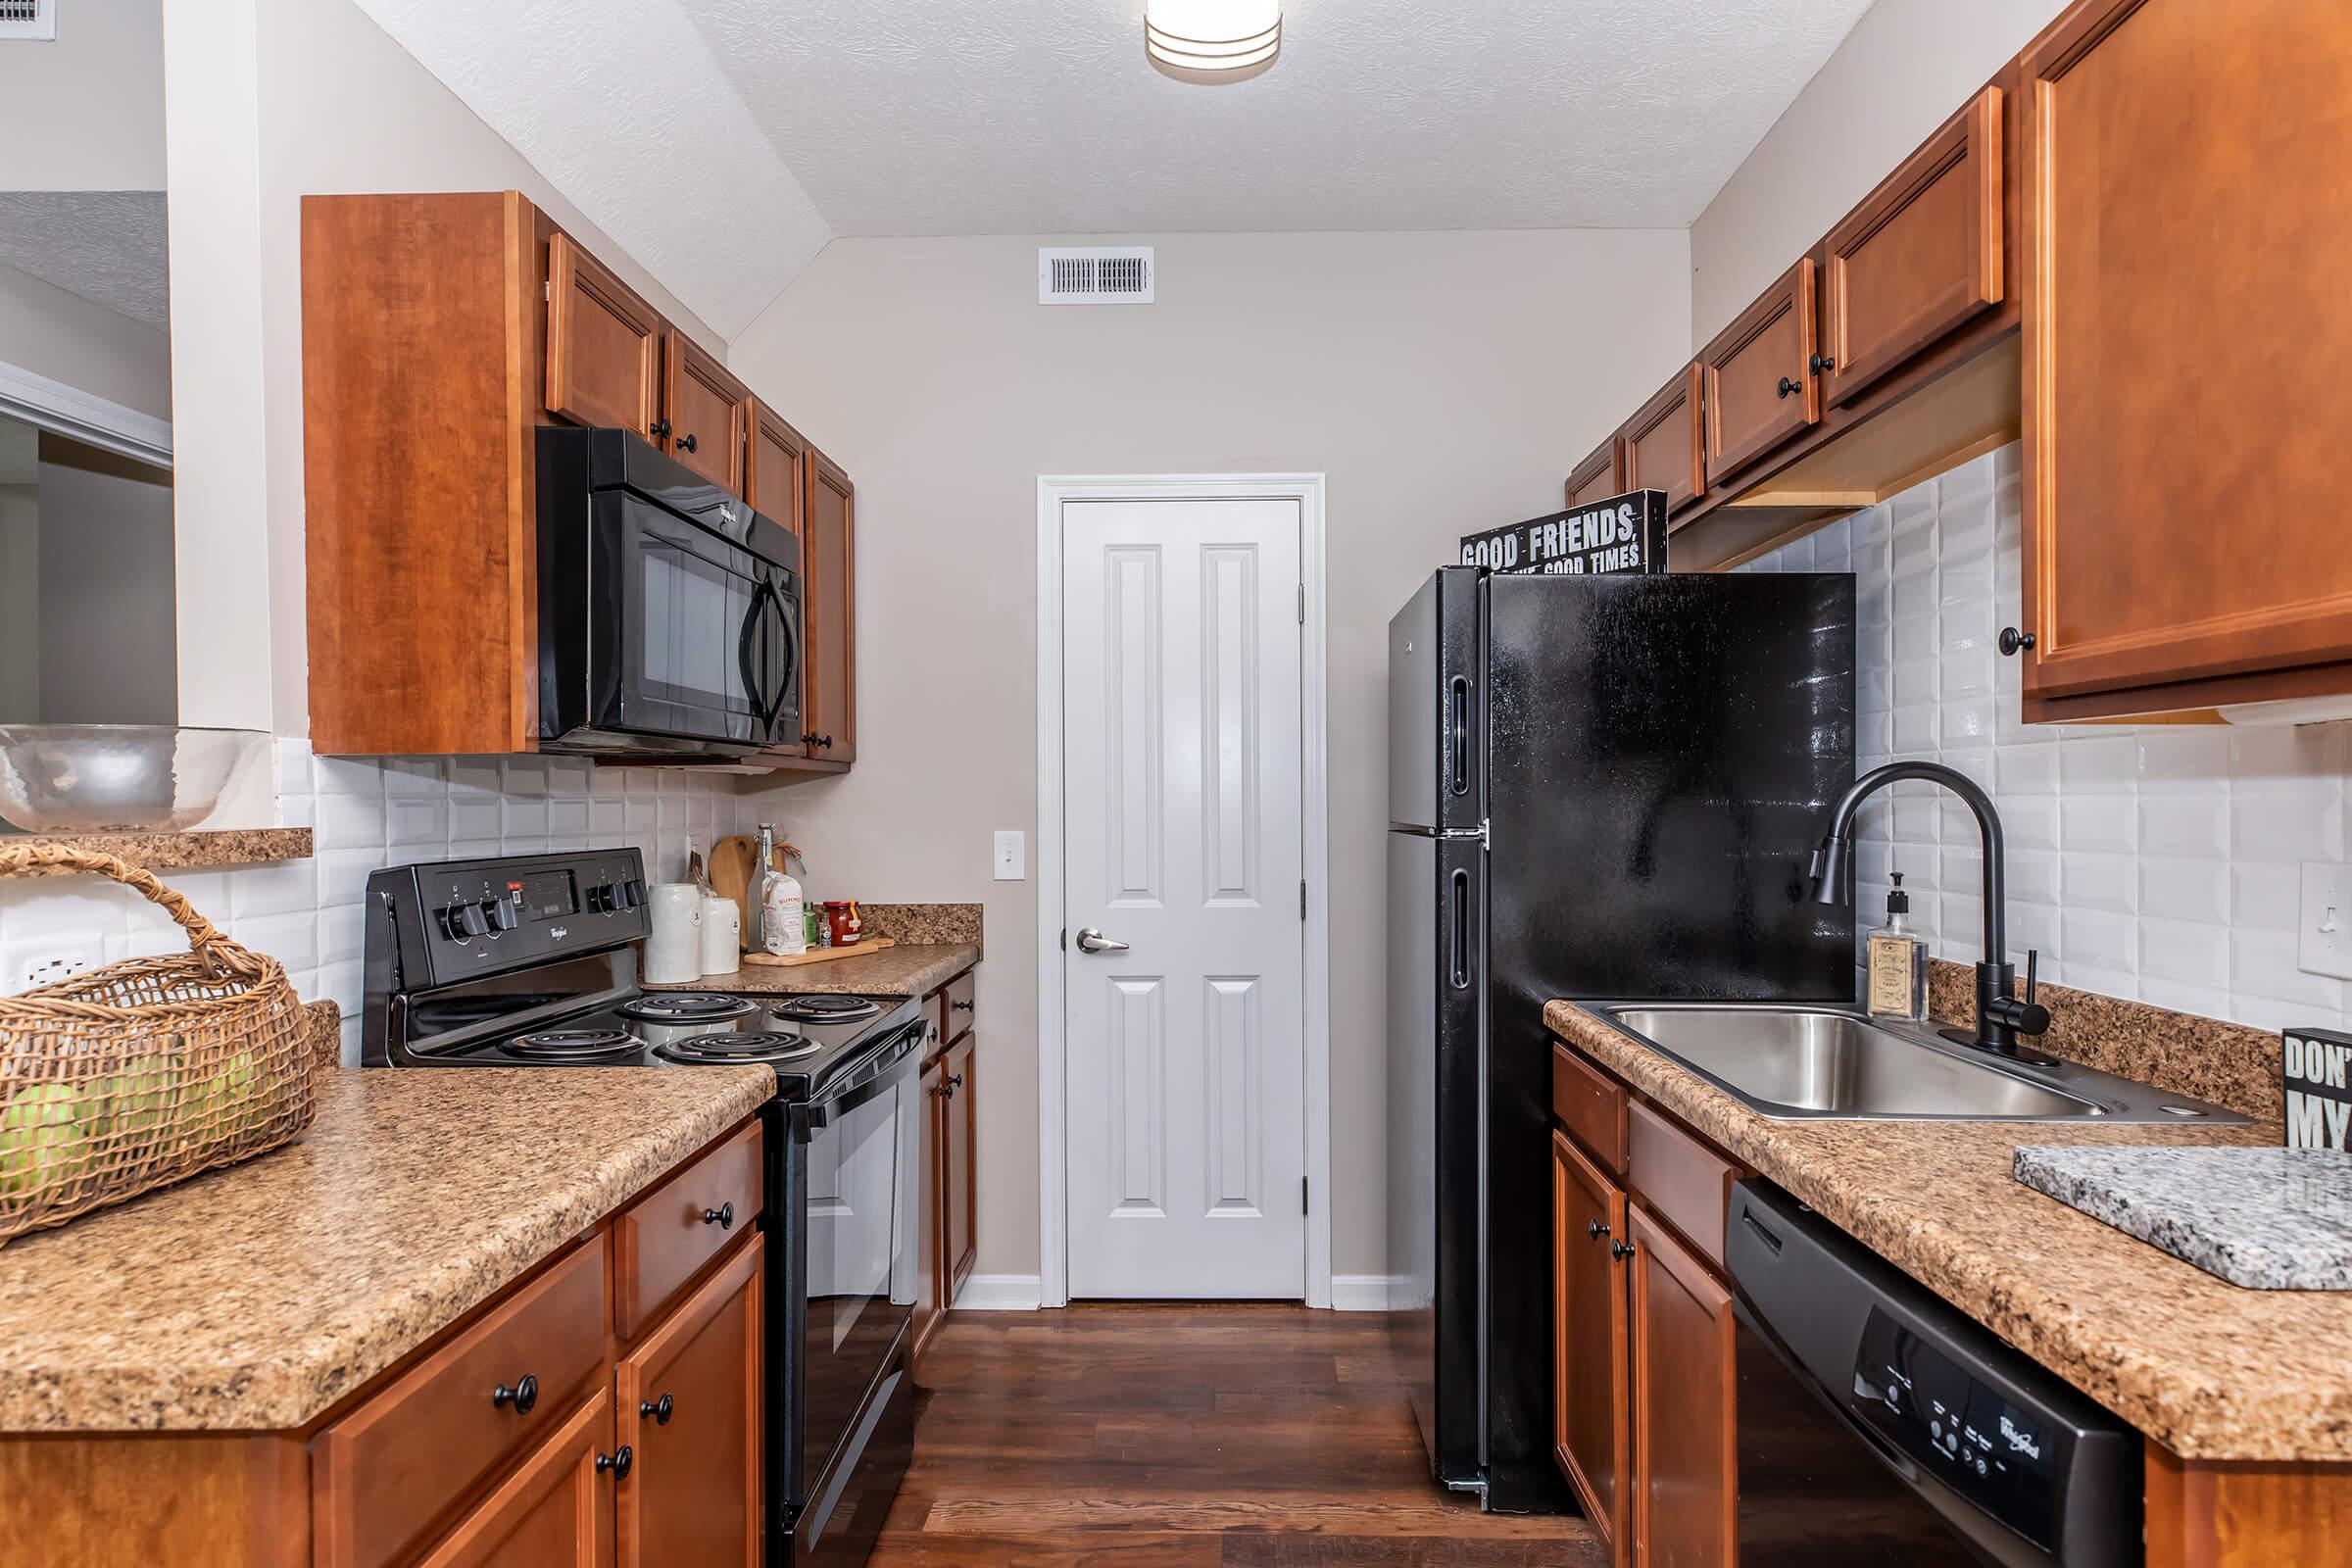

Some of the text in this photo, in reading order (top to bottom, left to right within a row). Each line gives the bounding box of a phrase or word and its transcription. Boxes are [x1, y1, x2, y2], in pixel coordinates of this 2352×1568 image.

[1462, 533, 1518, 570] GOOD
[2285, 1036, 2352, 1089] DON'
[2286, 1090, 2351, 1152] MY
[2000, 1416, 2039, 1460] Whirlpool
